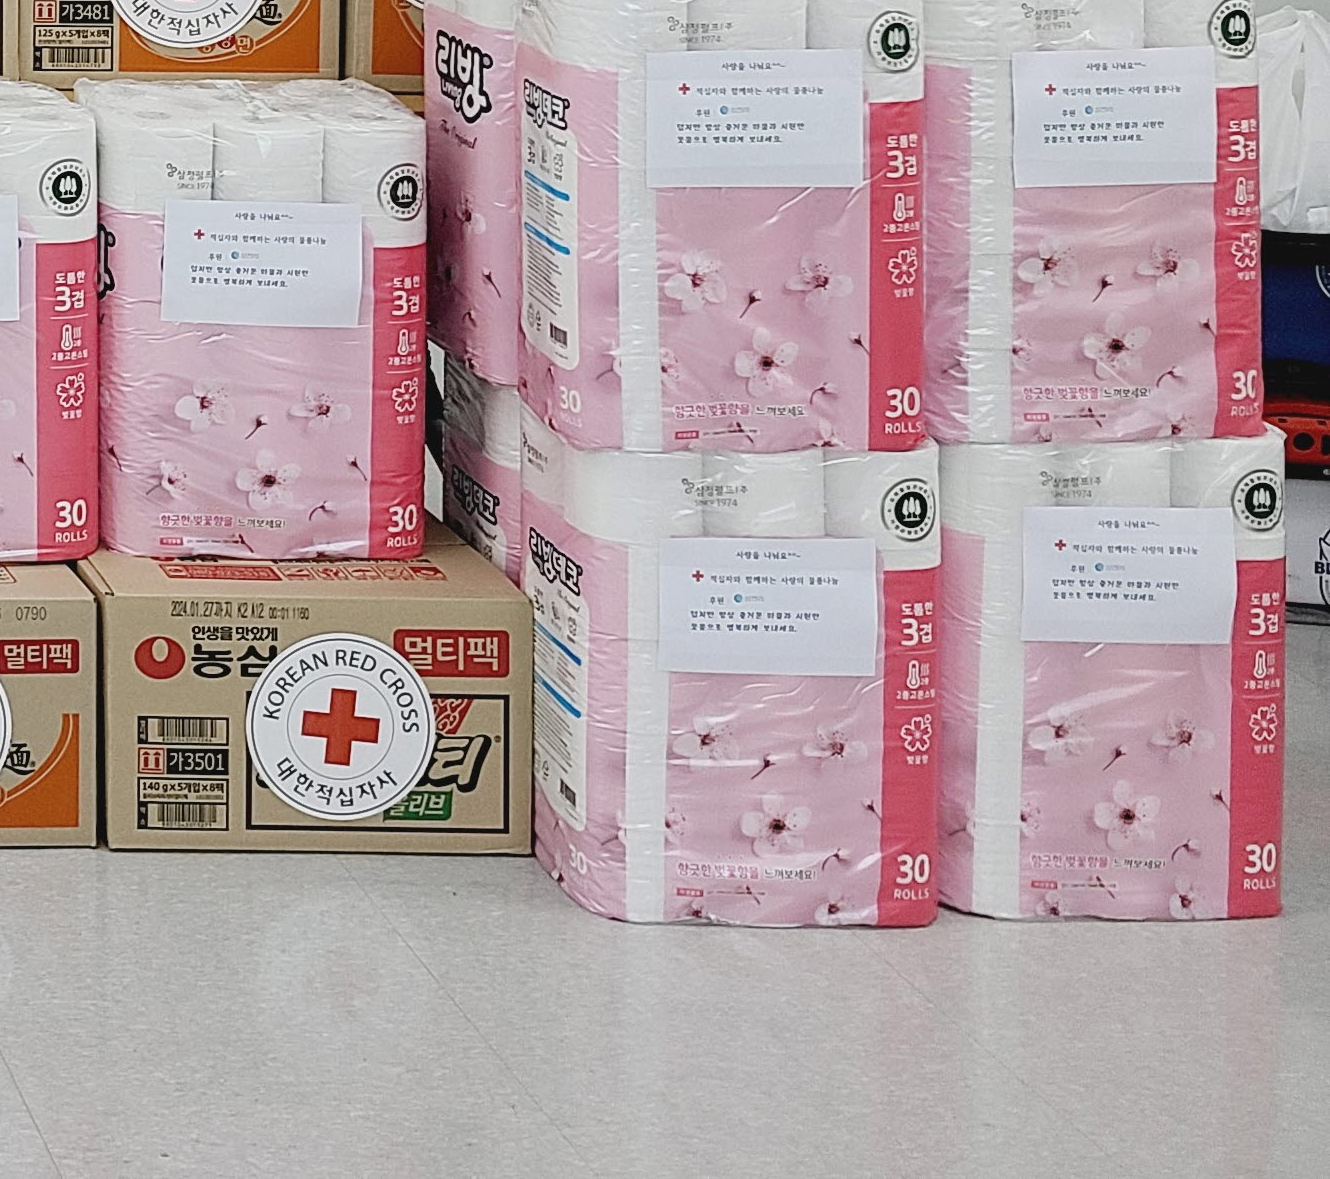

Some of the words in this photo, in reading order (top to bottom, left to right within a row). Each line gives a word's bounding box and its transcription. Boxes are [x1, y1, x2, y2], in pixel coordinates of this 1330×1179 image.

[55, 499, 87, 529] 30
[55, 529, 88, 544] ROLLS
[901, 601, 934, 617] 도톰한
[191, 626, 233, 641] 인생을
[235, 626, 278, 642] 맛있게
[901, 617, 933, 647] 3겹
[3, 643, 72, 670] 멀티팩
[191, 643, 278, 679] 농심
[262, 650, 329, 721] KOREAN
[335, 649, 377, 672] RED
[379, 668, 420, 733] CROSS
[169, 752, 225, 772] 가3501
[276, 756, 398, 808] 대한적십자사
[895, 853, 930, 885] 30
[1243, 842, 1277, 874] 30
[1243, 876, 1277, 891] ROLLS
